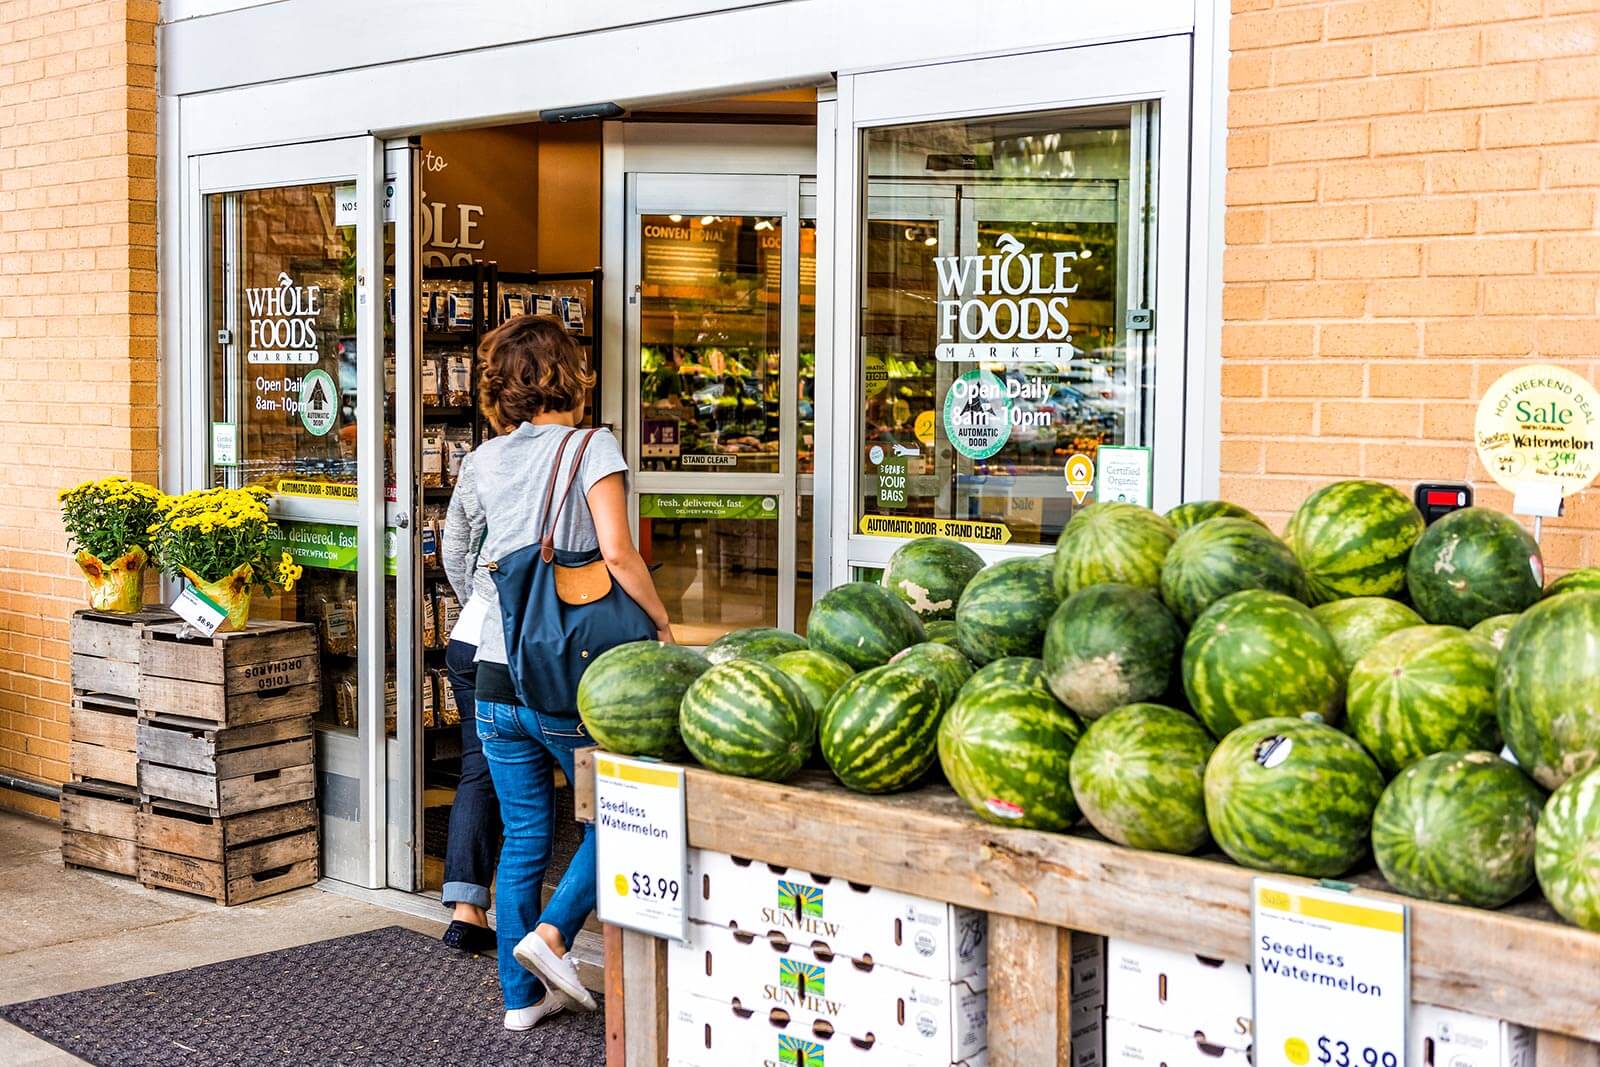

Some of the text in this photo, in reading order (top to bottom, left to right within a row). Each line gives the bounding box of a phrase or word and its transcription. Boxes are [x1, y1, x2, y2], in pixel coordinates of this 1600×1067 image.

[342, 203, 353, 211] NO
[932, 248, 1079, 296] WHOLE
[245, 284, 321, 317] WHOLE
[939, 296, 1071, 341] FOODS
[252, 352, 314, 362] MARKET
[945, 346, 1064, 358] MARKET
[256, 376, 281, 395] Open
[952, 377, 1053, 404] Open Daily
[1494, 378, 1596, 425] HOT WEEKEND DEAL
[1515, 400, 1574, 425] Sale
[958, 428, 999, 438] AUTOMATIC
[1512, 432, 1595, 451] Watermelon
[968, 438, 988, 448] DOOR
[683, 455, 729, 464] STAND CLEAR
[1106, 465, 1141, 477] Certified
[281, 483, 308, 495] AUTOMATIC
[308, 485, 322, 495] DOOR
[325, 486, 342, 496] STAND
[879, 475, 905, 488] YOUR
[1107, 475, 1139, 487] Organic
[657, 498, 745, 509] fresh. delivered. fast.
[881, 490, 904, 502] BAGS
[289, 528, 337, 546] delivered.
[867, 518, 913, 533] AUTOMATIC
[914, 520, 937, 536] DOOR
[944, 523, 973, 538] STAND
[974, 525, 1003, 541] CLEAR
[196, 615, 215, 630] $8.99
[244, 659, 303, 679] ORCHARDS
[258, 675, 290, 689] TOIGO
[600, 796, 646, 819] Seedless
[600, 814, 669, 840] Watermelon
[631, 871, 680, 902] $3.99
[760, 907, 840, 938] SUNVIEW
[1261, 935, 1345, 968] Seedless
[1261, 956, 1382, 998] Watermelon
[763, 984, 842, 1017] SUNVIEW
